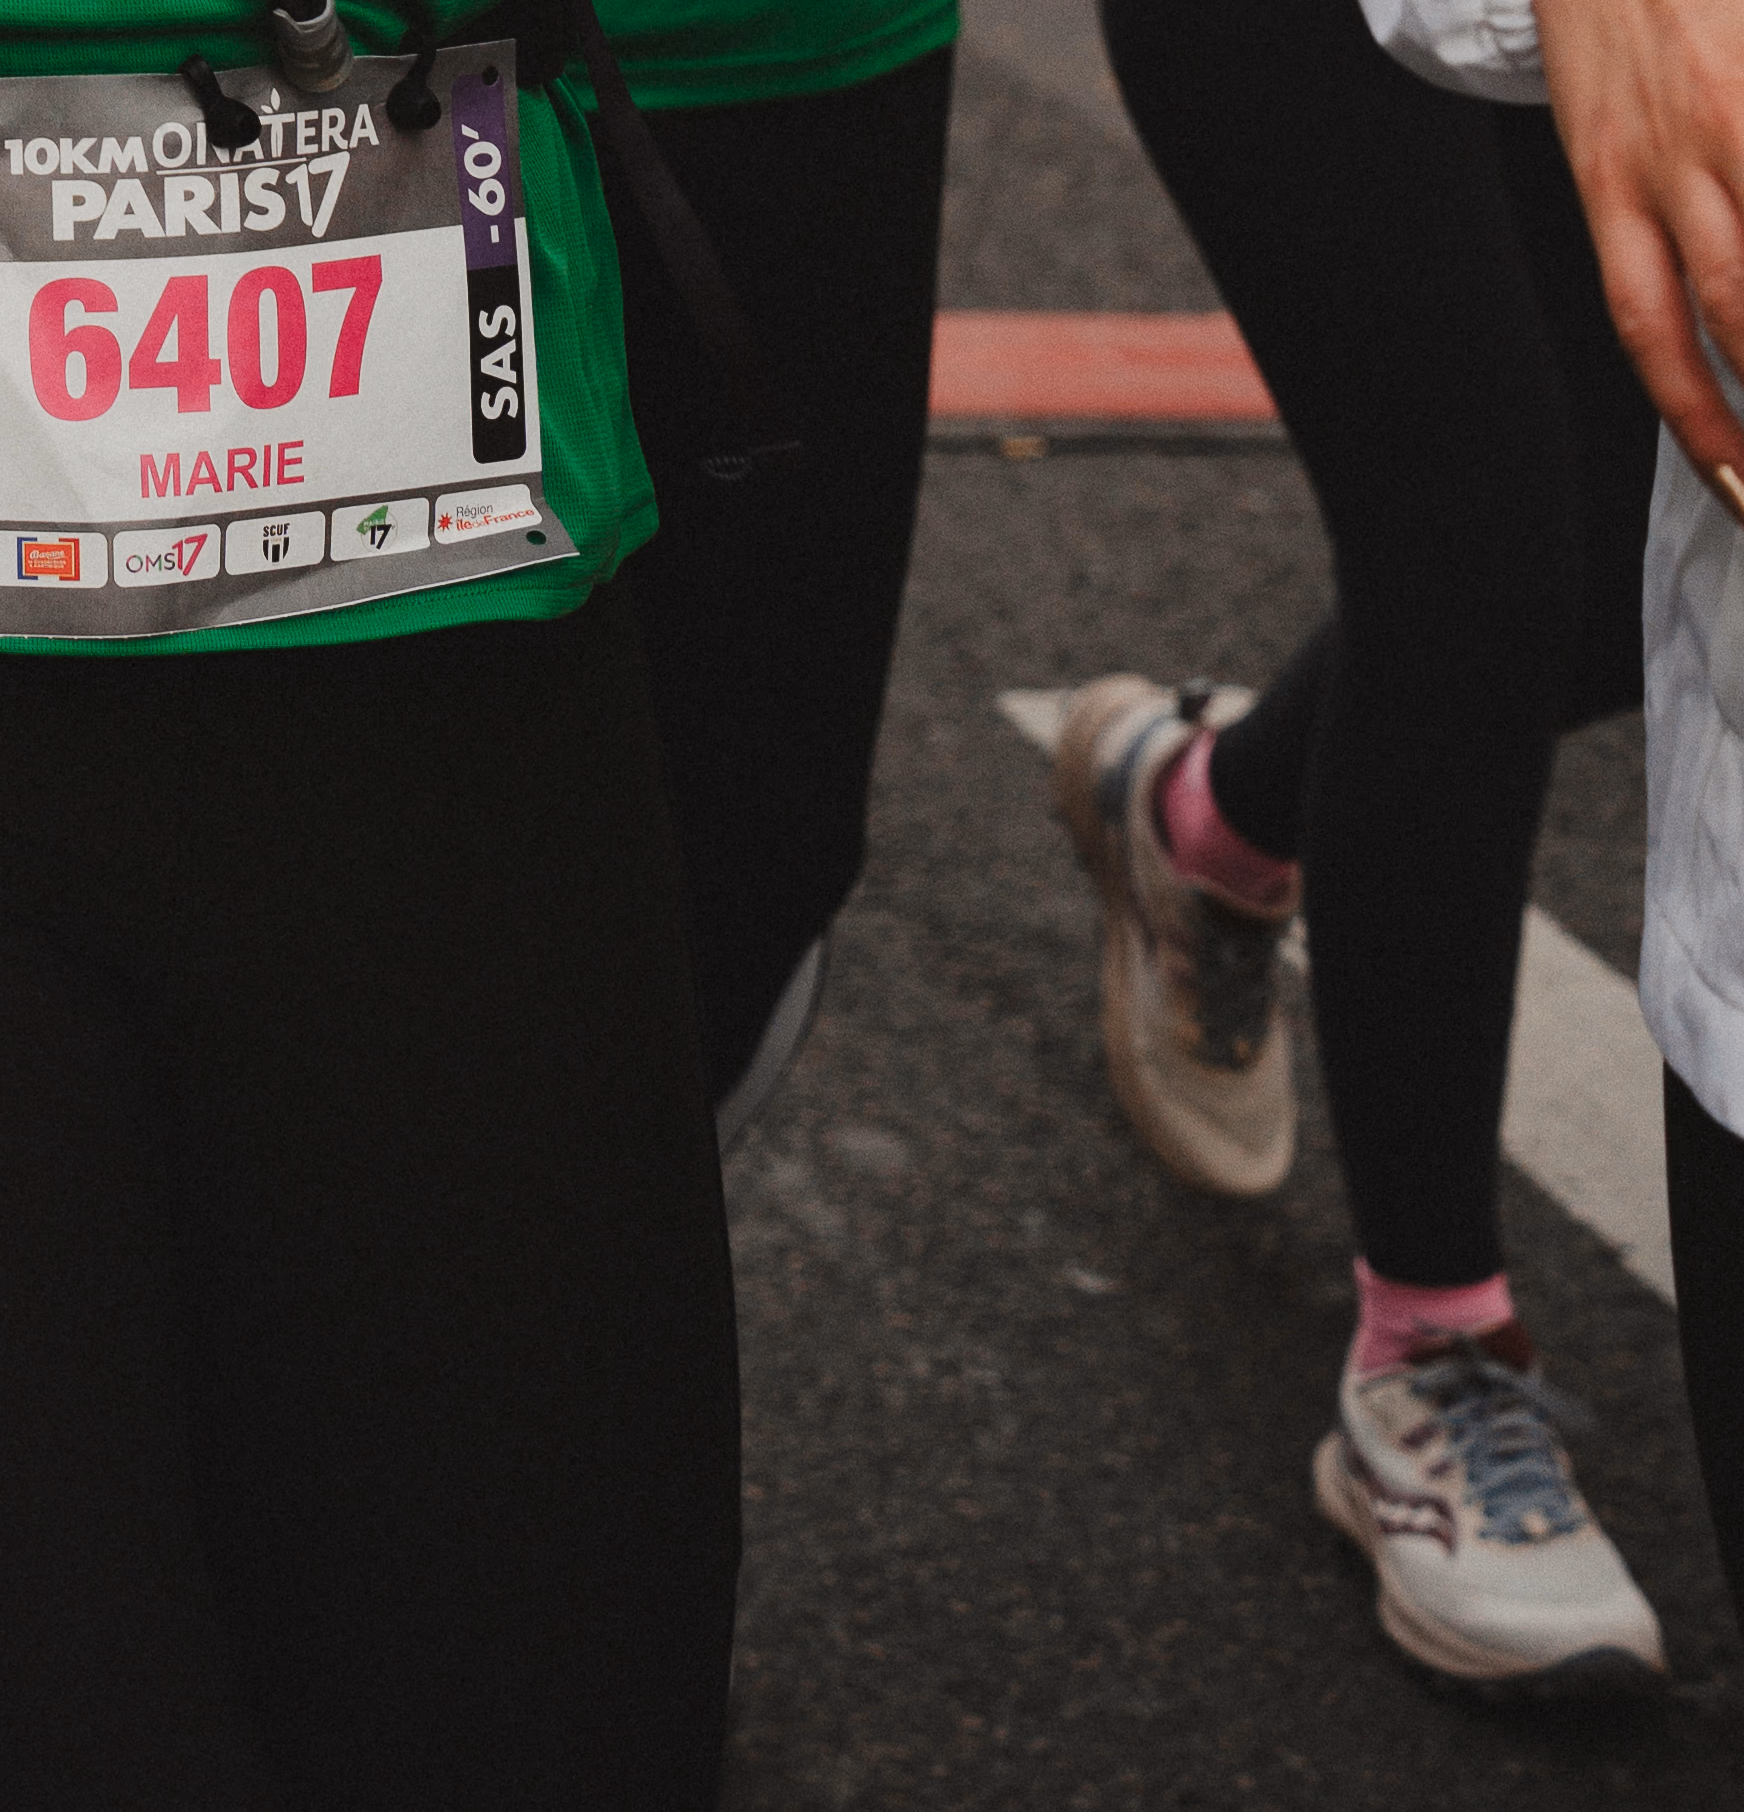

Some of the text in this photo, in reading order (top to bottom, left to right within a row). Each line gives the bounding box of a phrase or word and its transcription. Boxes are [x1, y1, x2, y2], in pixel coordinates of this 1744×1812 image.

[28, 253, 383, 422] 6407
[478, 305, 520, 420] SAS
[139, 440, 306, 499] MARIE
[263, 523, 290, 537] SCUF
[456, 504, 494, 519] Région
